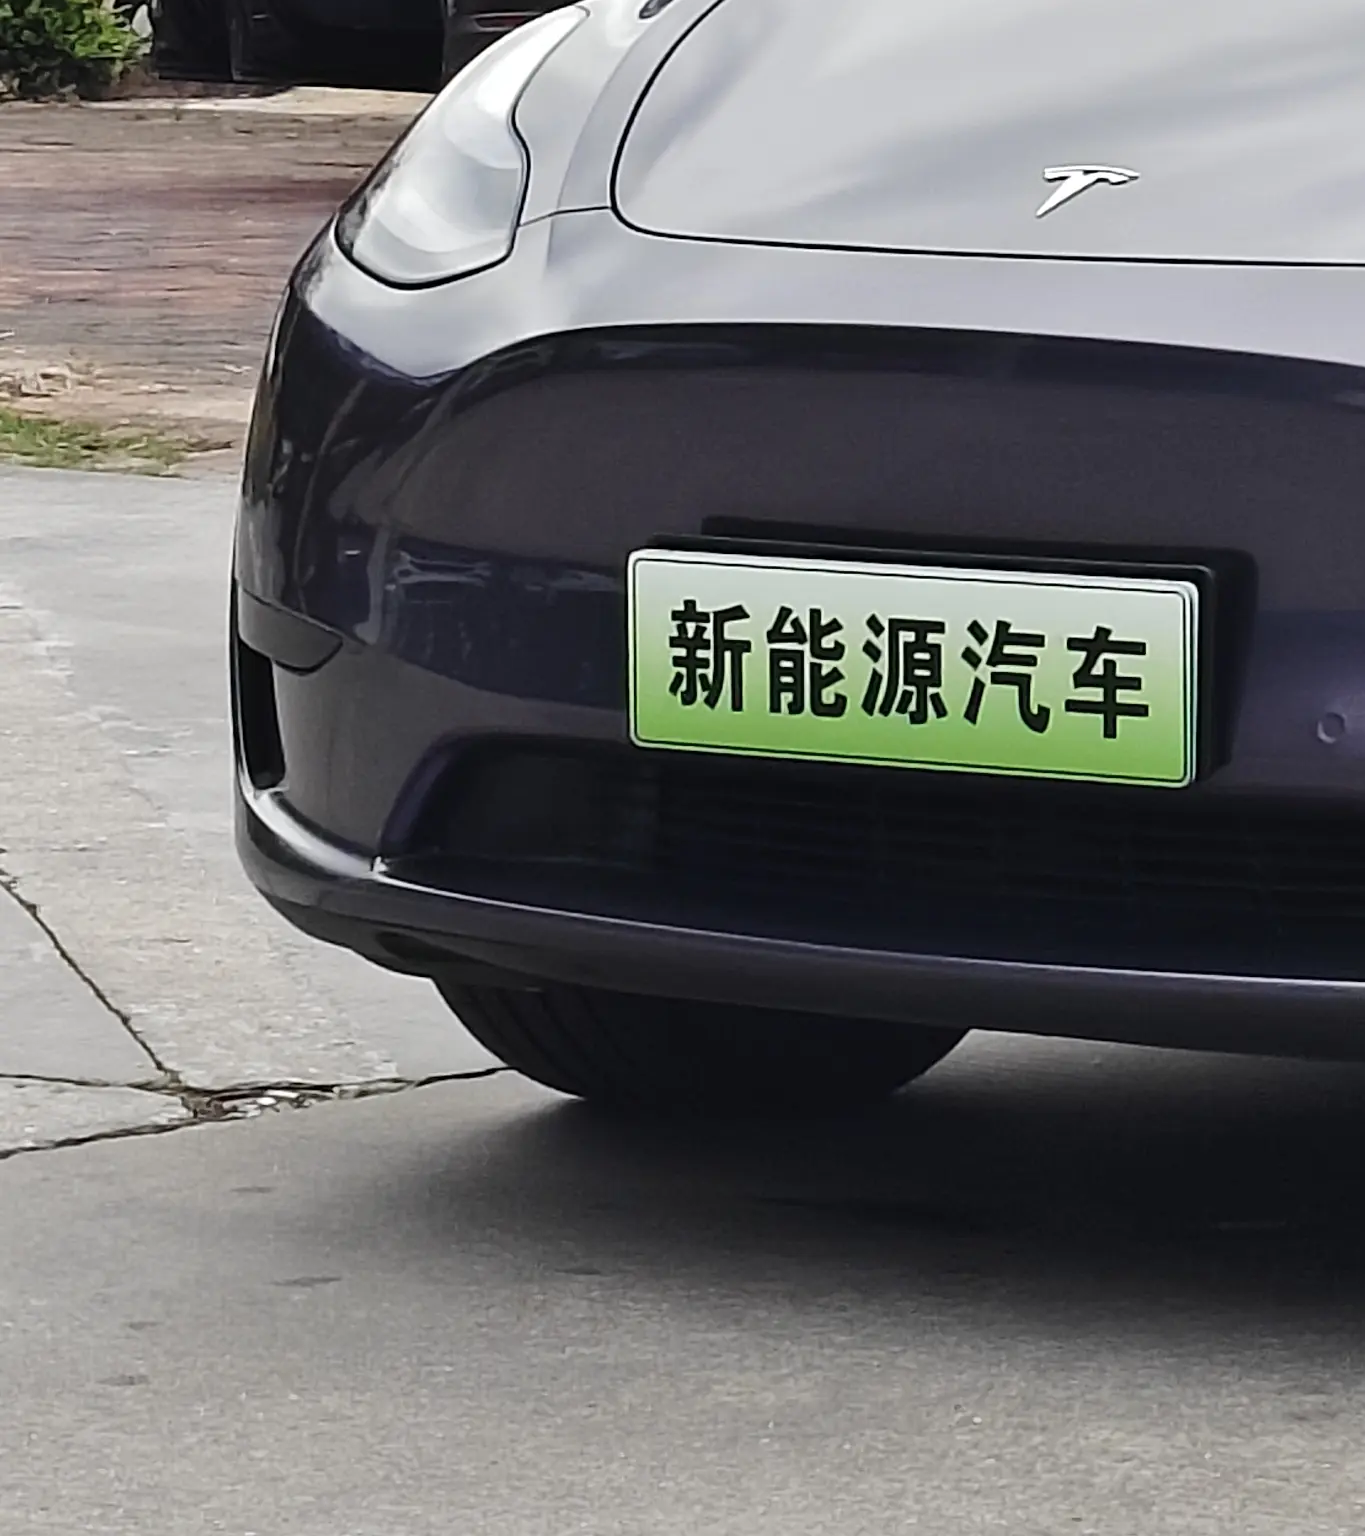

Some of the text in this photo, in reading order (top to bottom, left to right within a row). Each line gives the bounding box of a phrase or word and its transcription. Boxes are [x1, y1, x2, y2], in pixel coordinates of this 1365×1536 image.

[667, 598, 1151, 739] 新能源汽车
